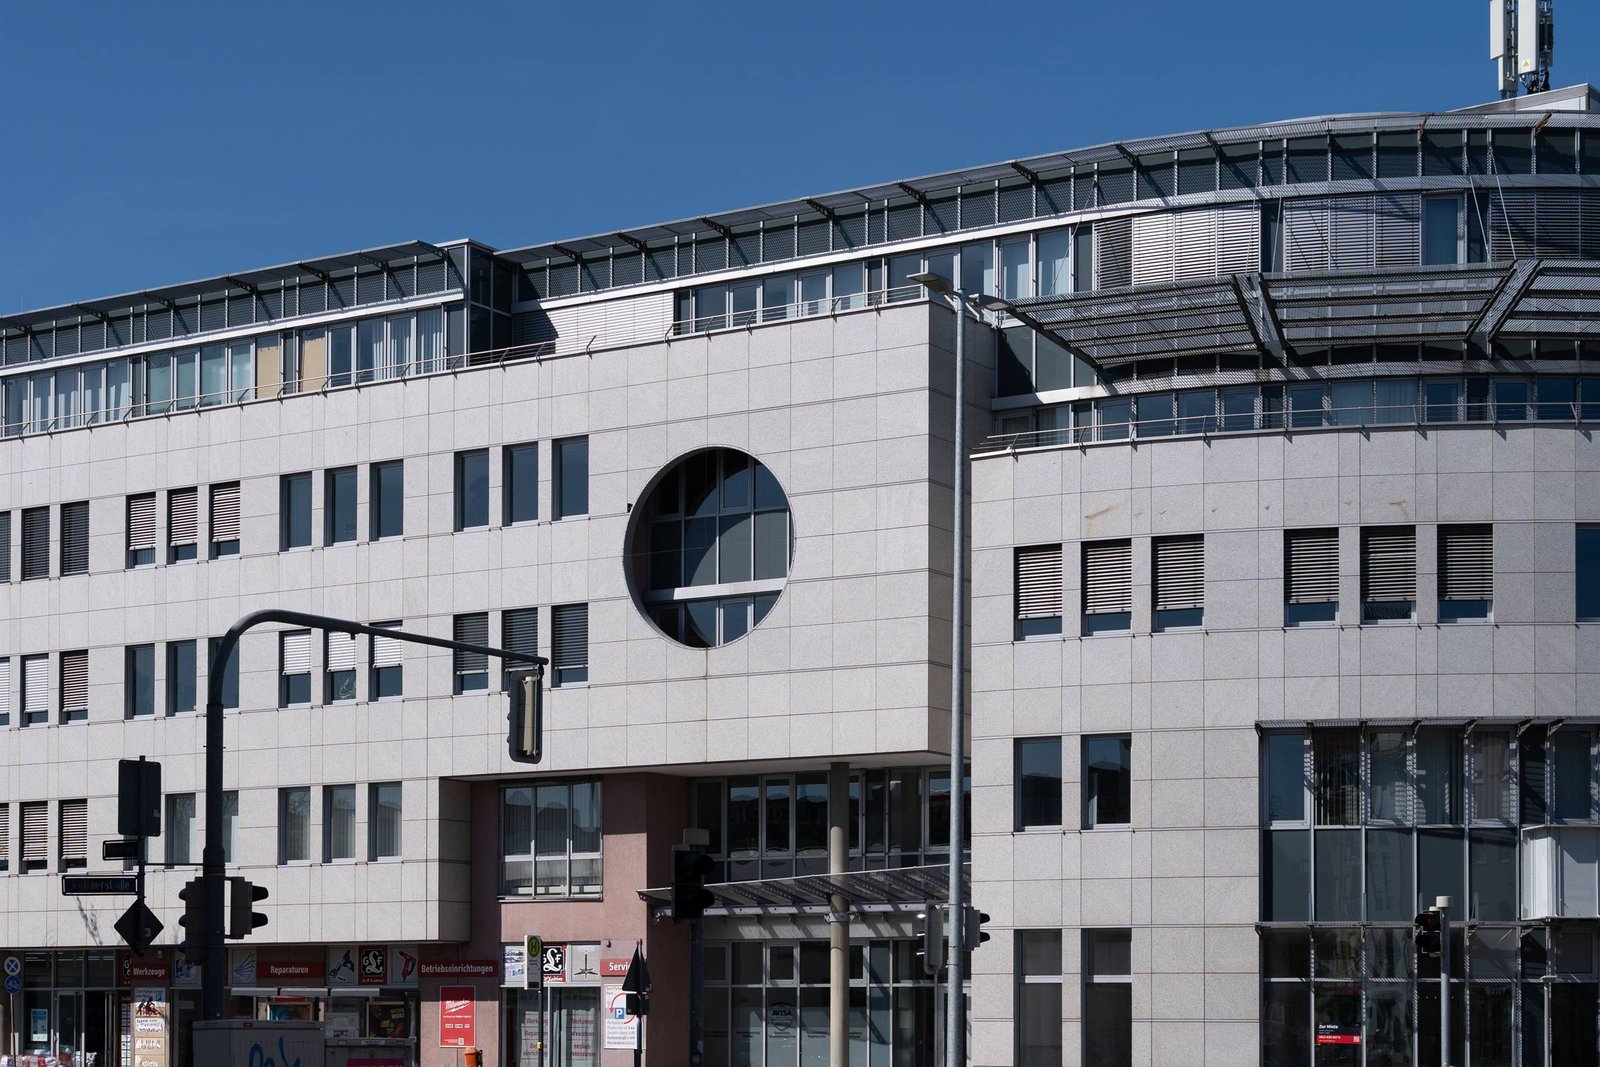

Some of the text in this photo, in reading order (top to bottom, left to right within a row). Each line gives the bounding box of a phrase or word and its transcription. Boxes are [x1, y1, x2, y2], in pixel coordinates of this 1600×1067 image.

[132, 967, 166, 977] Werkzeuge
[270, 965, 309, 975] Reparaturen
[421, 964, 494, 974] Betriebseinrichtungen
